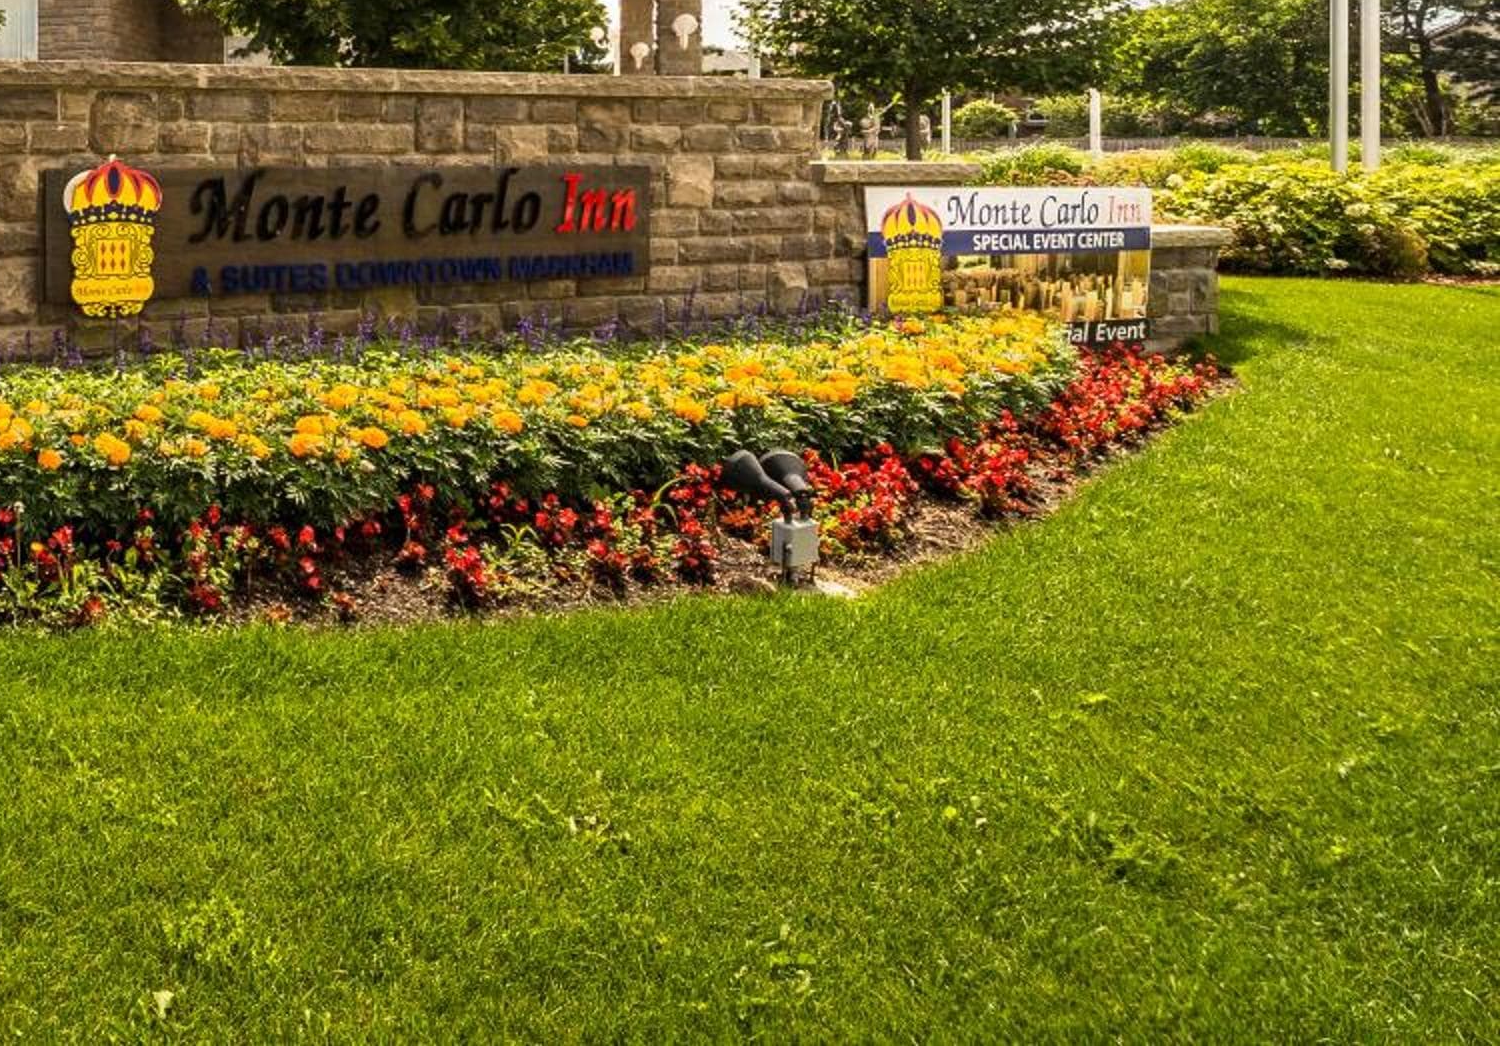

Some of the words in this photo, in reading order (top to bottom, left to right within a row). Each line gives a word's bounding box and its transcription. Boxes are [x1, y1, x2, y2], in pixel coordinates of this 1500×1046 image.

[188, 170, 380, 244] Monte
[404, 167, 541, 241] Carlo
[555, 172, 639, 235] Inn
[947, 191, 1031, 227] Monte
[1039, 189, 1099, 226] Carlo
[1107, 196, 1142, 224] Inn
[973, 232, 1030, 251] SPECIAL
[1033, 232, 1076, 250] EVENT
[1078, 231, 1125, 249] CENTER
[221, 262, 328, 293] SUITES
[335, 256, 501, 288] DOWNTOWN
[1065, 322, 1090, 343] ial
[1095, 321, 1146, 342] Event
